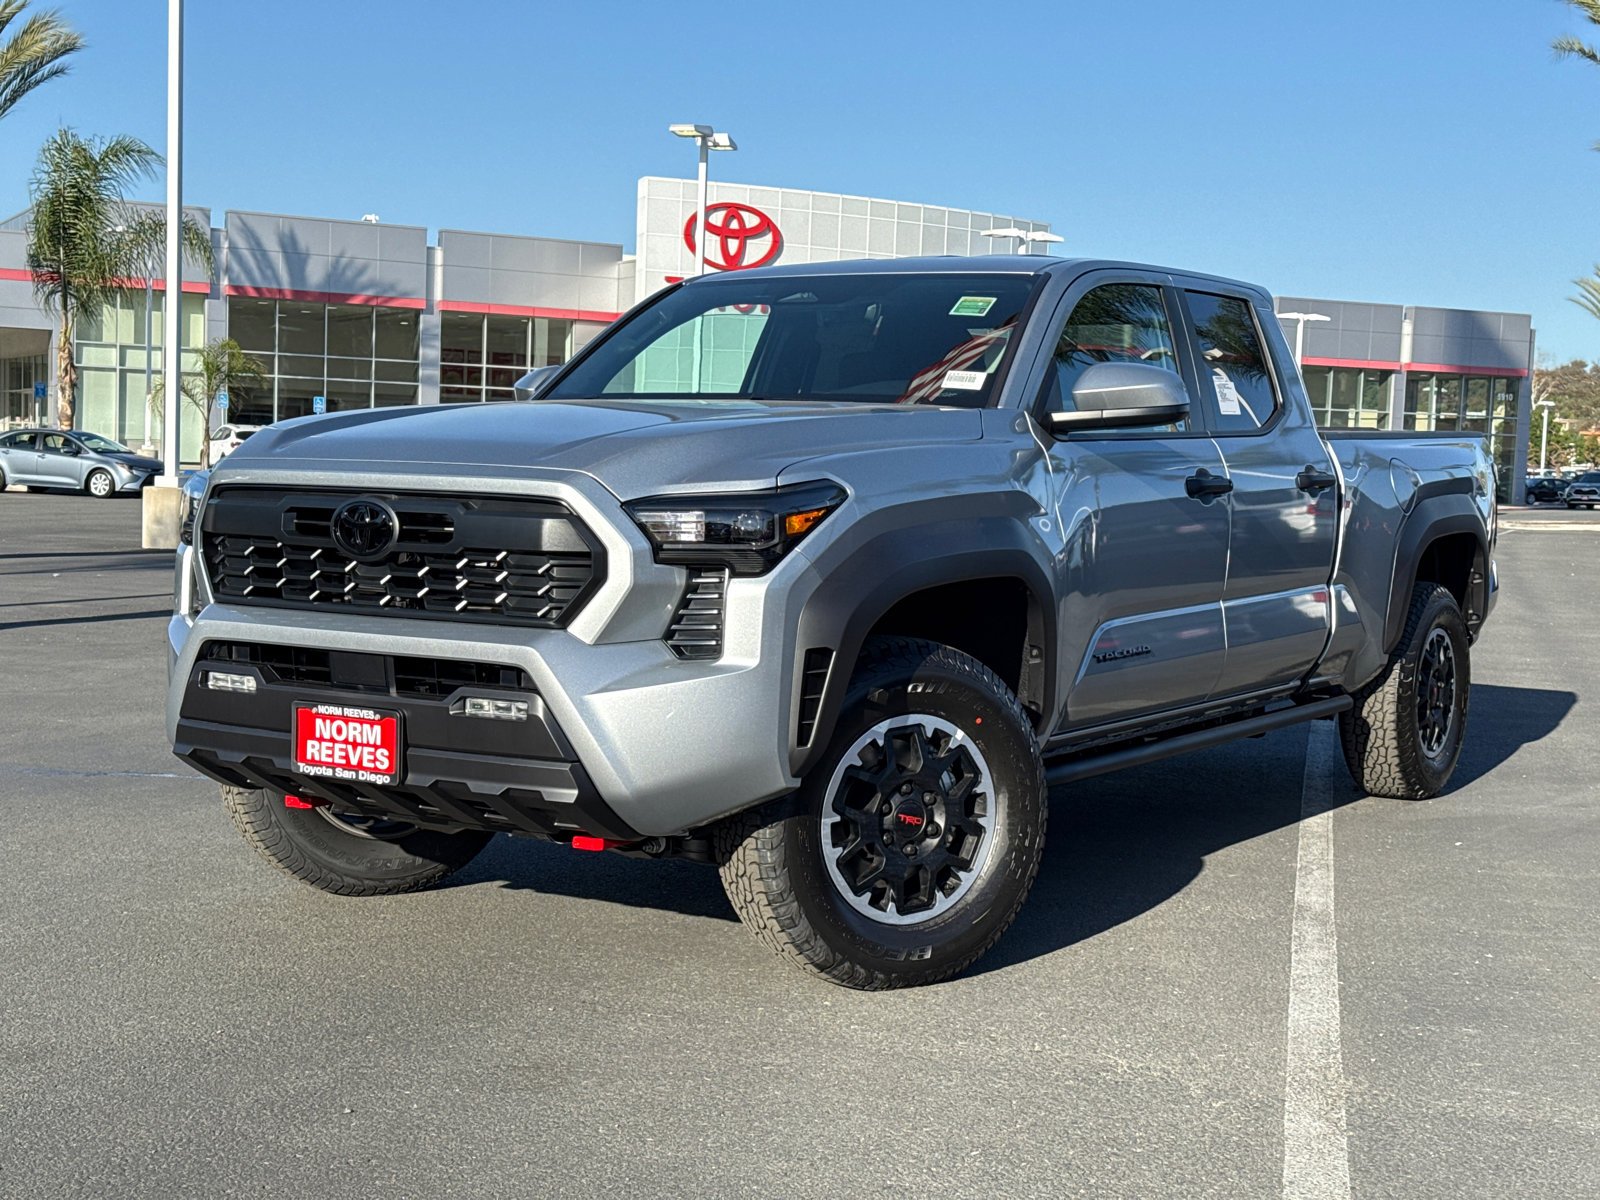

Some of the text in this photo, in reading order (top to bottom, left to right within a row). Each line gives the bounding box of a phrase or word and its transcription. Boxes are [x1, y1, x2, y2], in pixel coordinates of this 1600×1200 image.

[1093, 645, 1151, 663] TACOMA
[318, 705, 375, 719] NORM REEVES
[306, 718, 390, 770] NORM REEVES
[297, 762, 390, 785] Toyota San Diego
[898, 813, 923, 826] TRD
